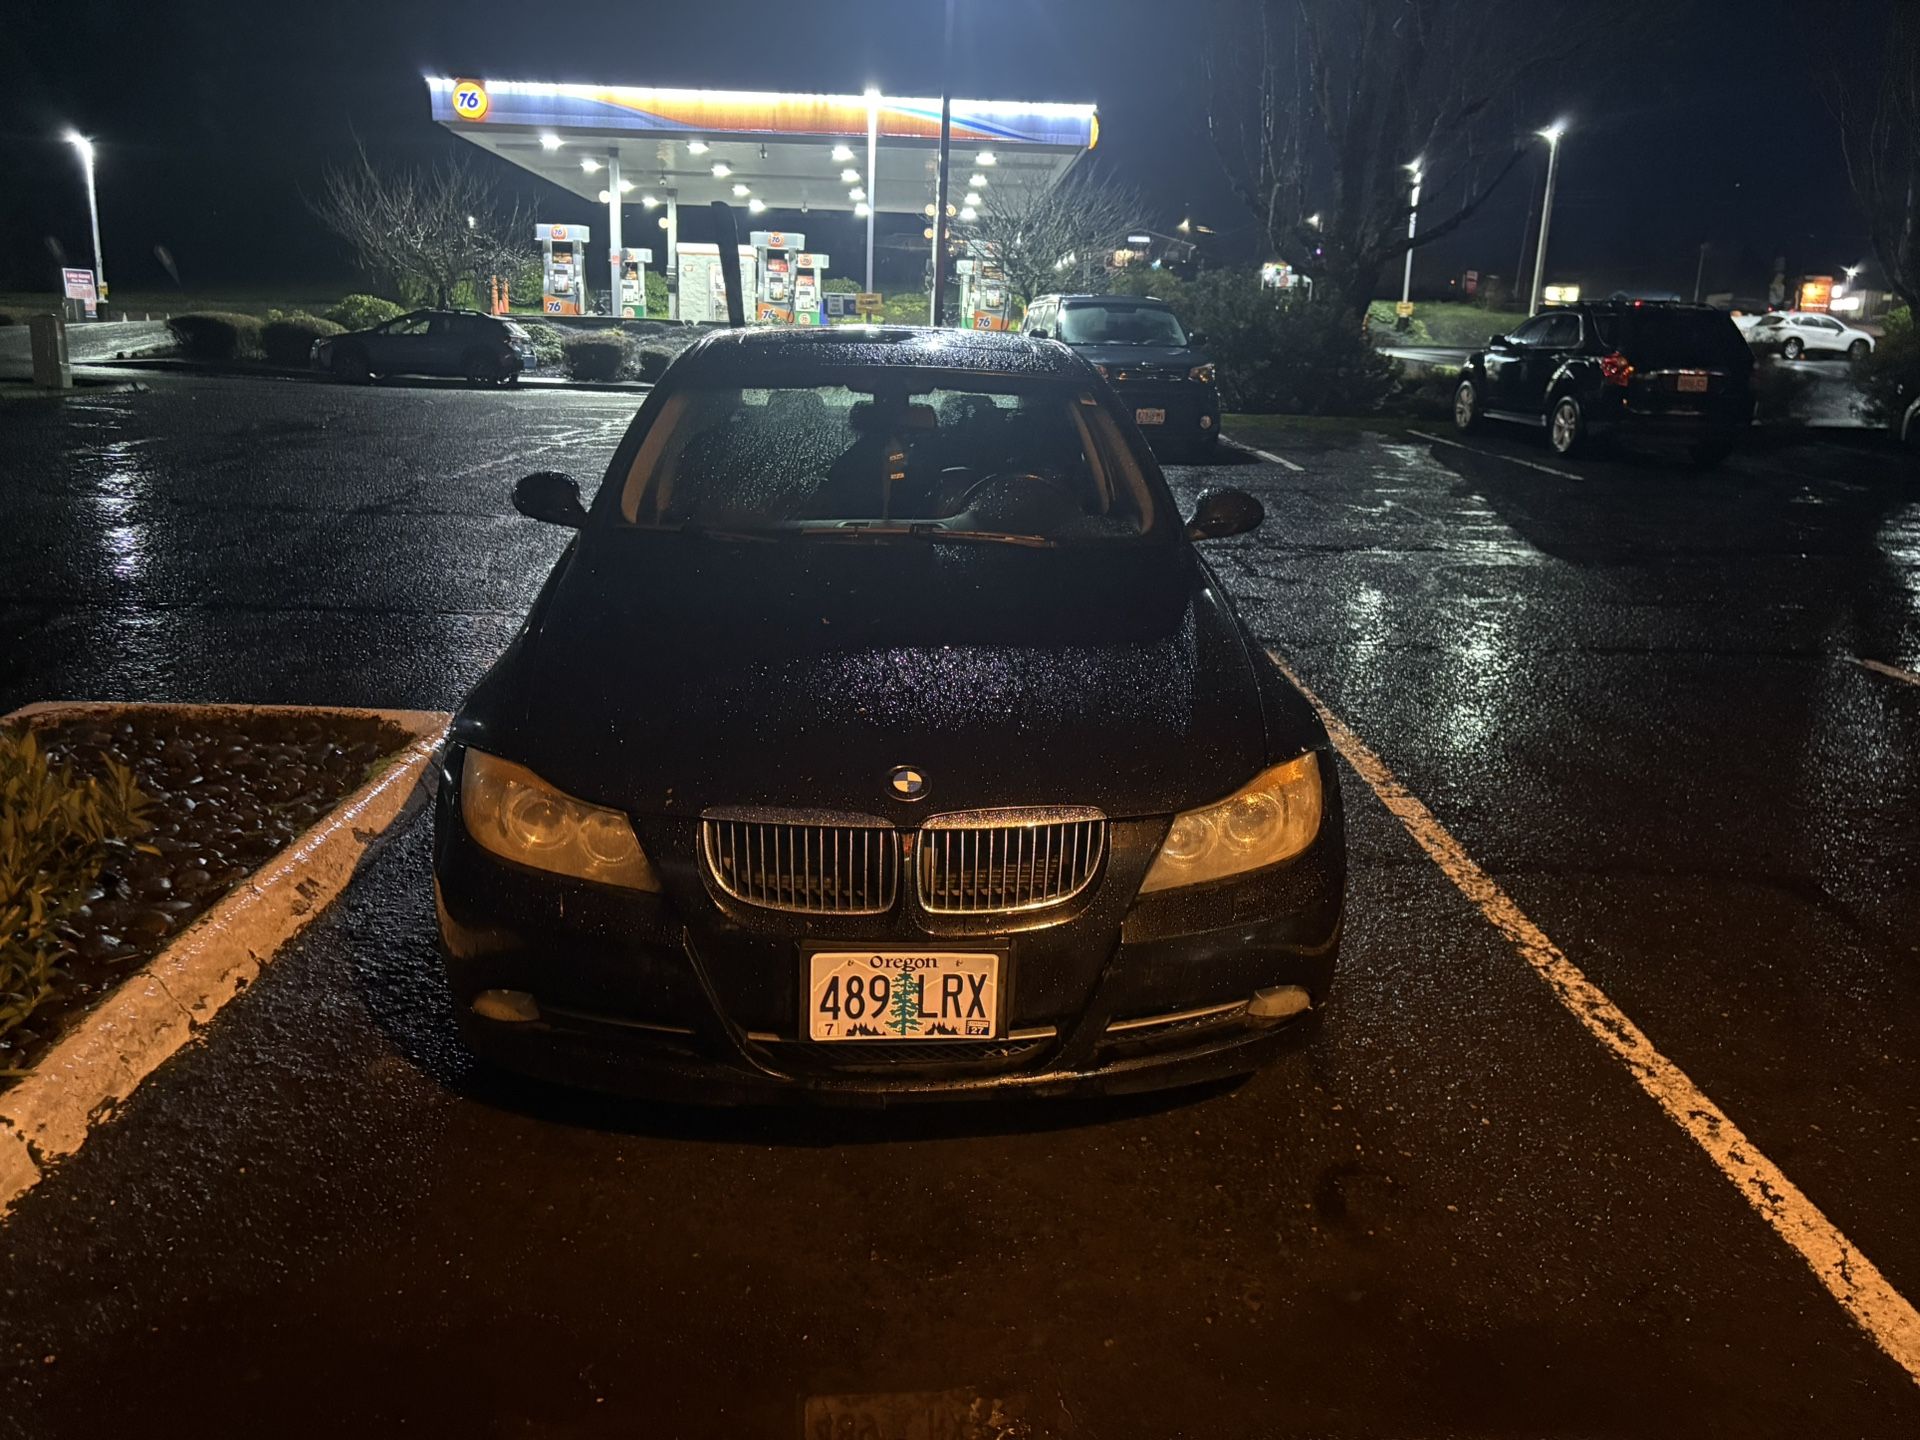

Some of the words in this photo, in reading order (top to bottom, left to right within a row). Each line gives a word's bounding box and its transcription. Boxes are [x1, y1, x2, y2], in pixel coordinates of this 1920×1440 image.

[459, 92, 479, 108] 76
[548, 302, 561, 312] 76
[762, 309, 777, 319] 76
[978, 317, 991, 327] 76
[869, 955, 938, 972] Oregon
[819, 974, 891, 1020] 489
[917, 973, 988, 1019] LRX
[824, 1023, 834, 1036] 7
[970, 1026, 984, 1035] 27
